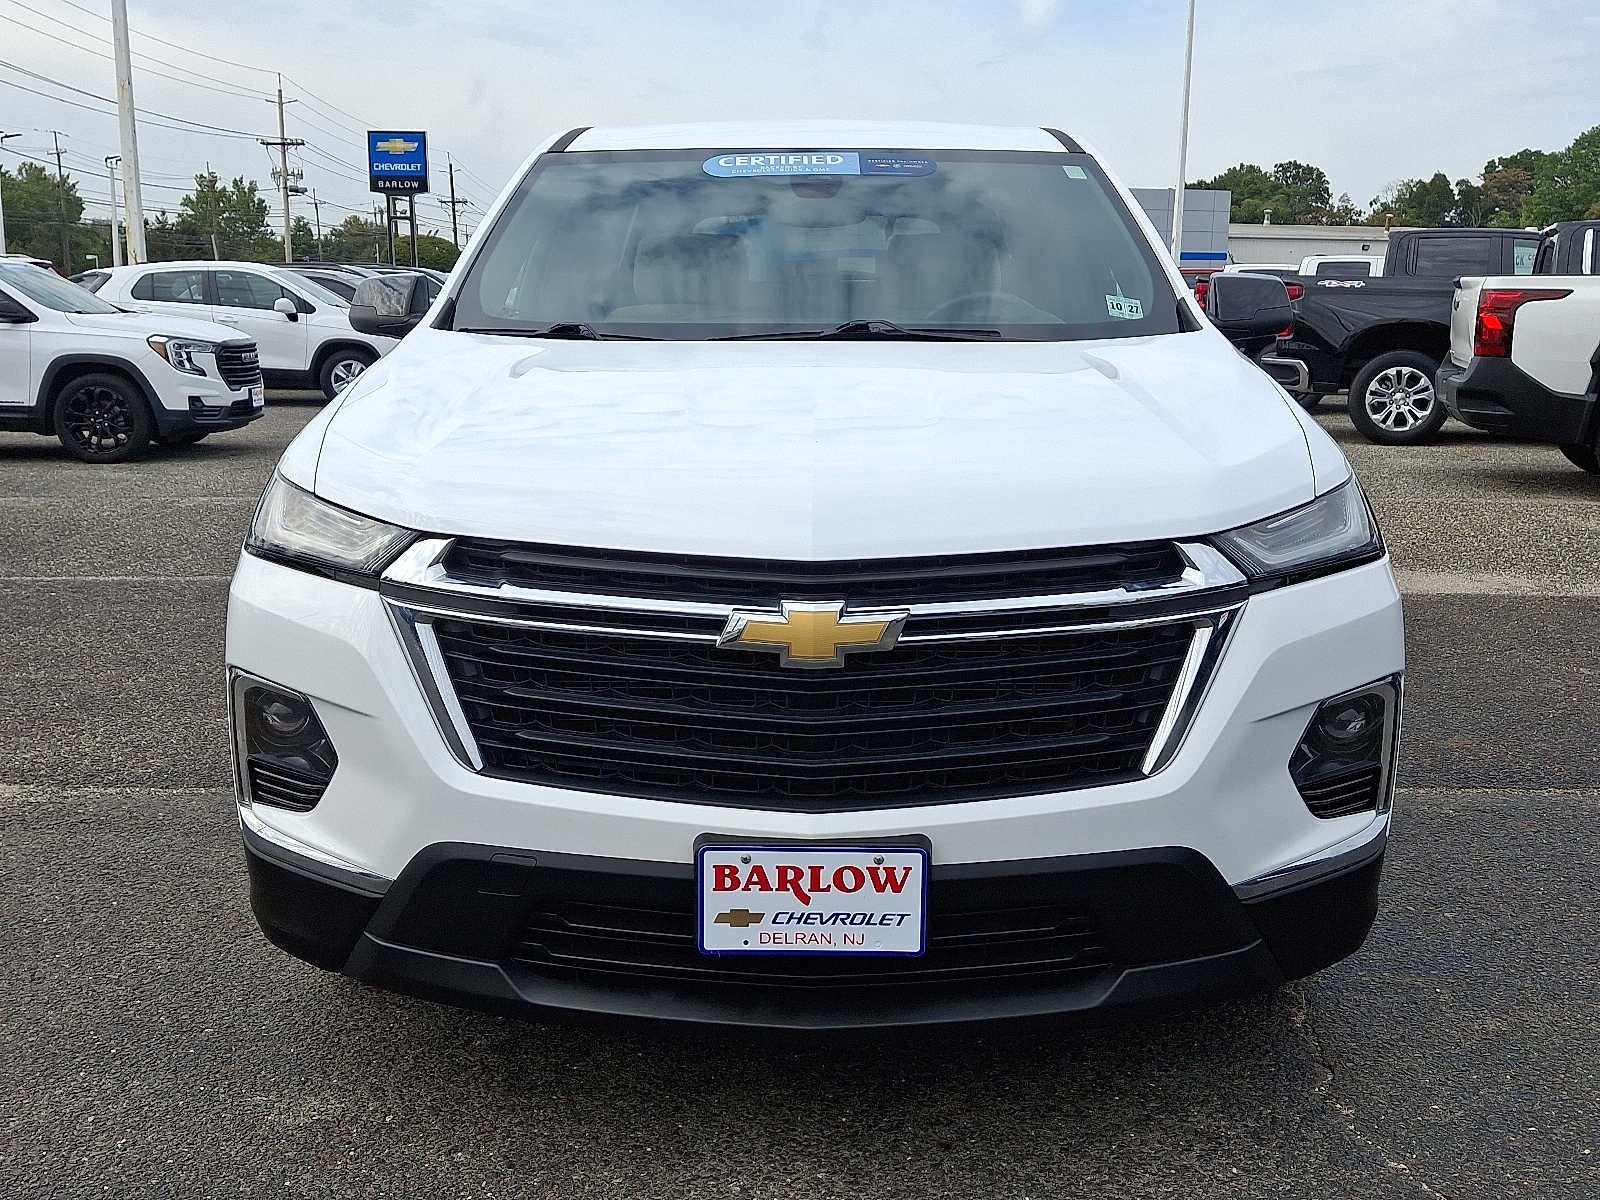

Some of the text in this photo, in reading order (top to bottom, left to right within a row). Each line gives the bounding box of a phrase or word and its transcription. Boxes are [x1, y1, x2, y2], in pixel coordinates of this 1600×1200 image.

[373, 162, 422, 171] CHEVROLET
[718, 155, 844, 167] CERTIFIED
[378, 180, 419, 189] BARLOW
[1110, 301, 1139, 314] 10 27
[712, 864, 913, 907] BARLOW
[771, 911, 911, 927] CHEVROLET
[759, 932, 865, 947] DELRAN, NJ
